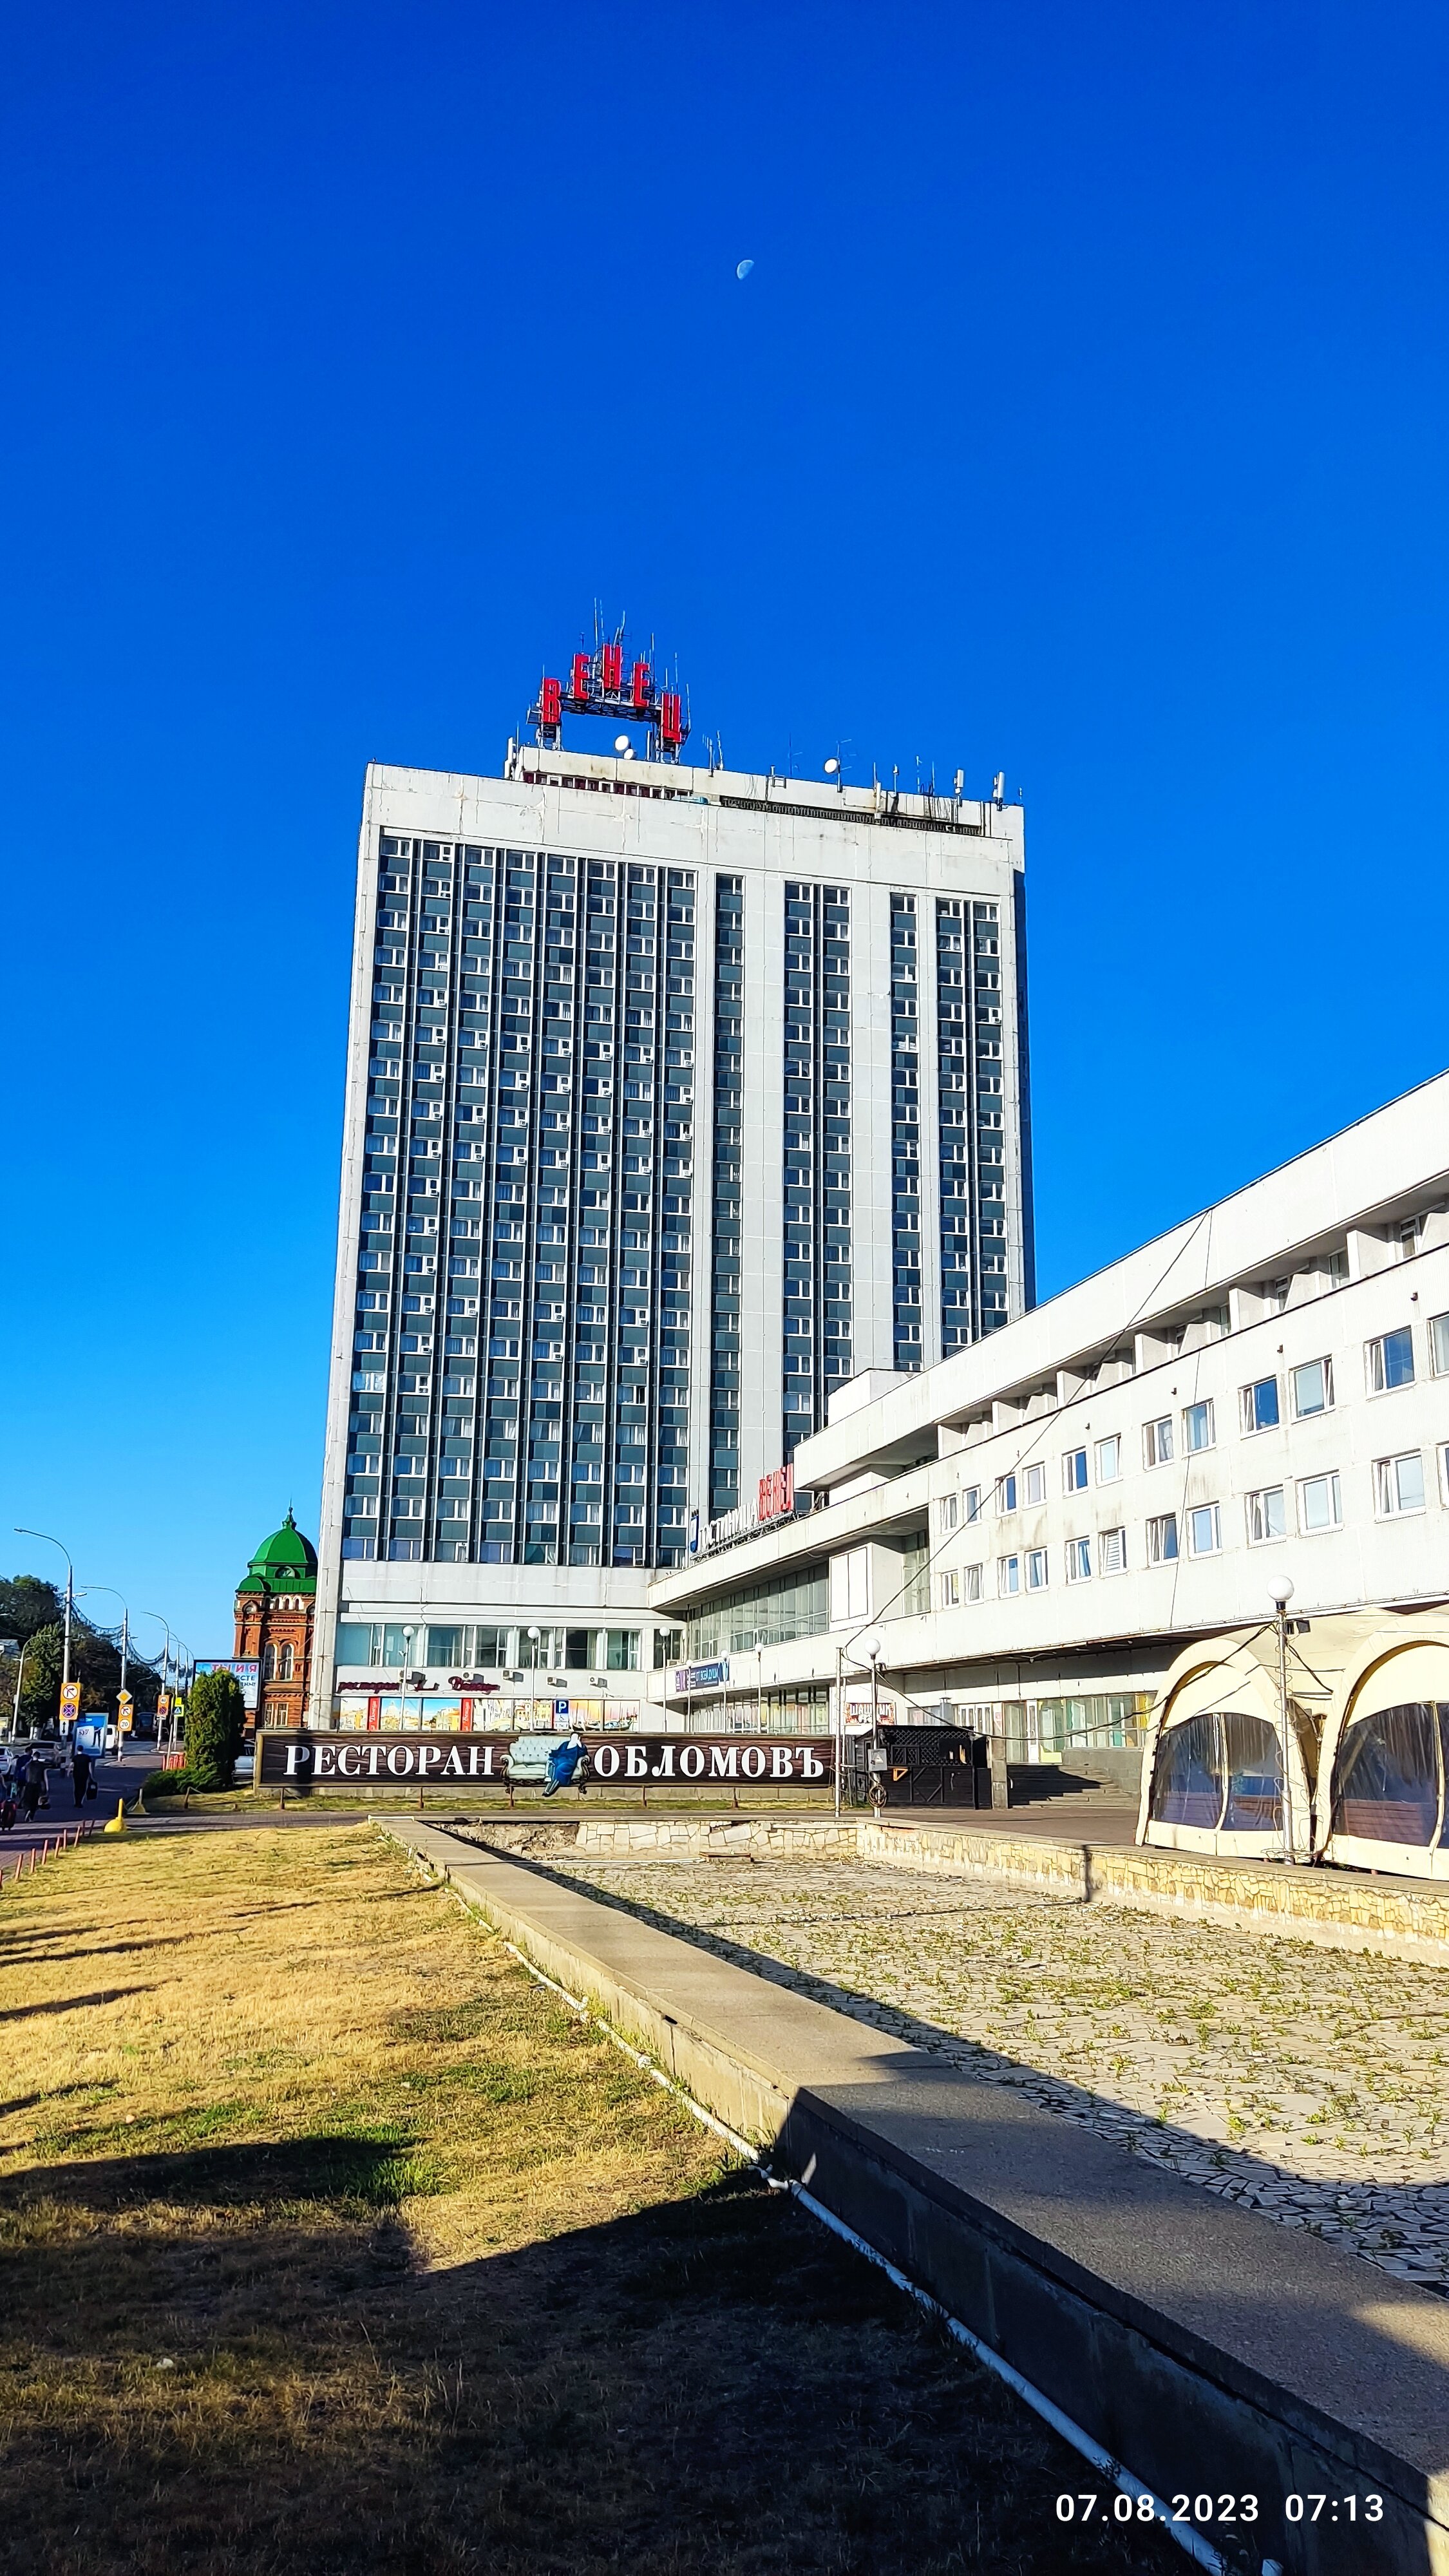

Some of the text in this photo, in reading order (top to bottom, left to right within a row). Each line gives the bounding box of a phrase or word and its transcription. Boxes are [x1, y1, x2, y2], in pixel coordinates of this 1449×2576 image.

[542, 643, 682, 743] ВЕНЕЦ
[697, 1463, 793, 1551] ГОСТИНИЦА ВЕНЕЦ
[558, 1701, 567, 1713] P
[283, 1745, 824, 1778] РЕСТОРАН ОБЛОМОВЪ
